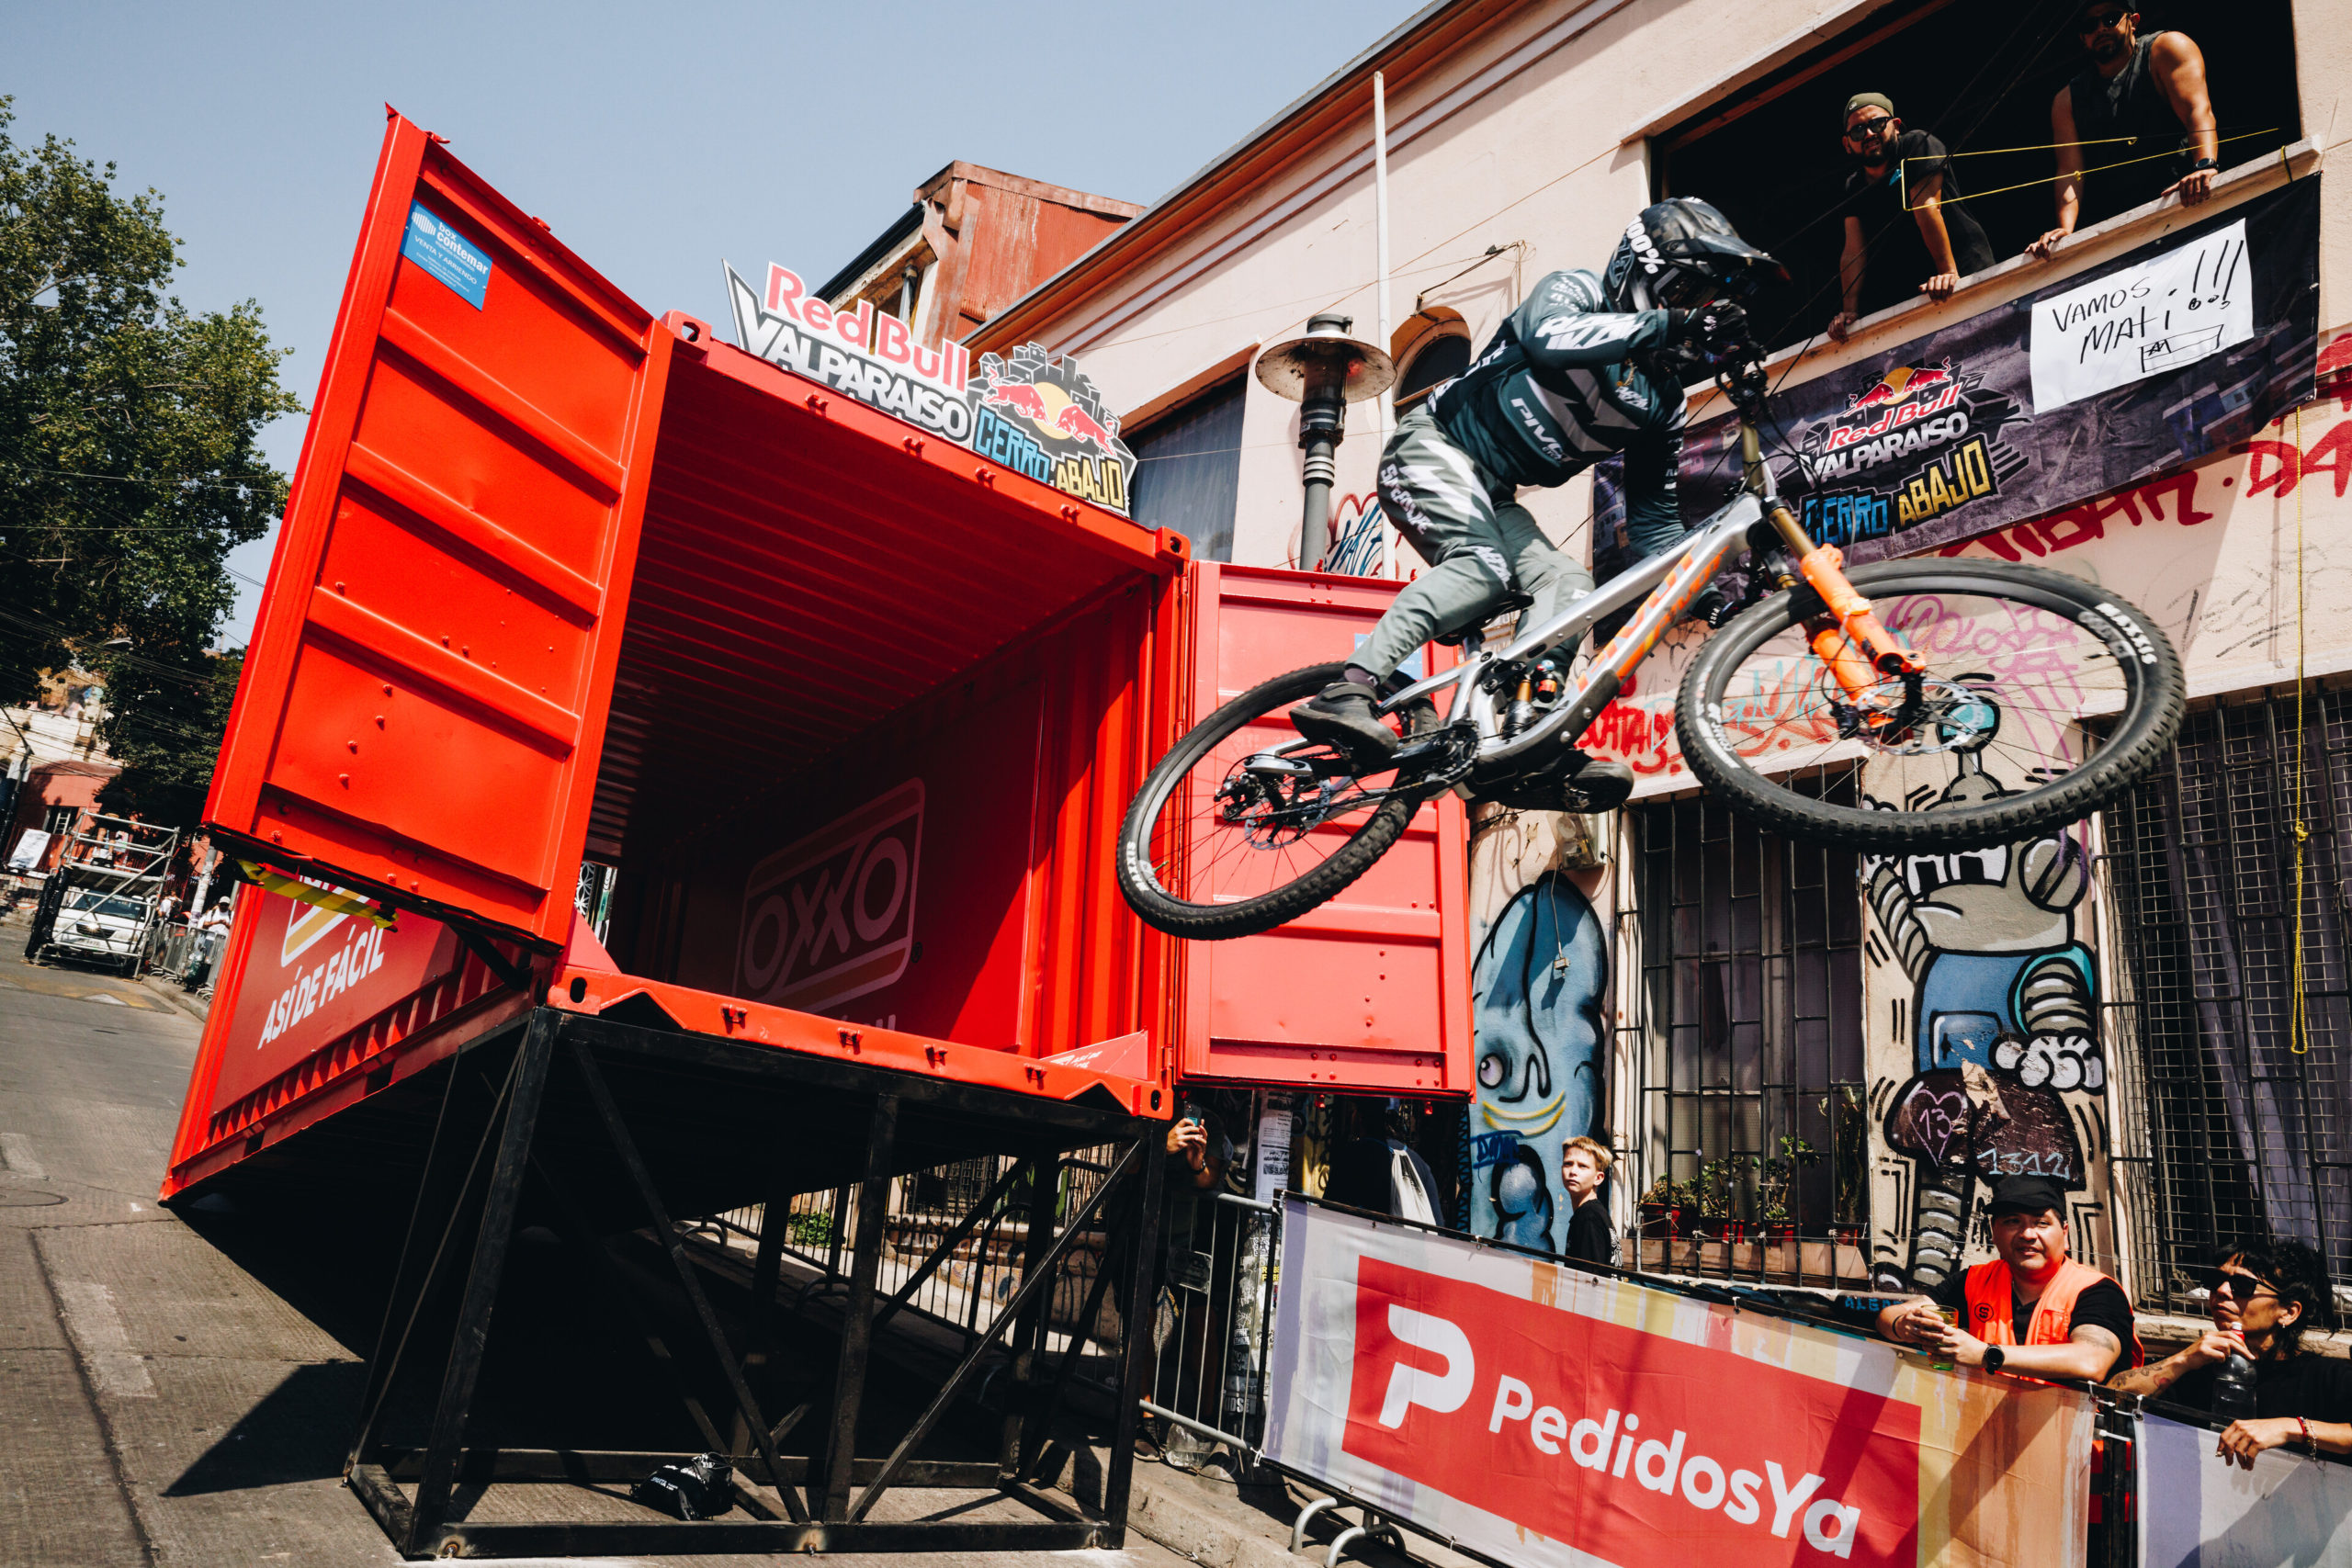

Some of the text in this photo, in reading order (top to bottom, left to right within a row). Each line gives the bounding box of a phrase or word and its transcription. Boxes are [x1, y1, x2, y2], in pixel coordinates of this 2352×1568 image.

[414, 235, 437, 254] VENTA
[443, 257, 477, 285] ARRIENDO
[436, 231, 488, 275] contemar
[438, 222, 457, 241] box
[1626, 215, 1666, 275] 100%
[767, 264, 968, 393] Red Bull
[2052, 276, 2151, 332] VAMOS
[732, 274, 970, 440] VALPARAISO
[976, 407, 1051, 484] CERRO
[1825, 382, 1963, 452] Red Bull
[1800, 412, 1968, 490] VALPARAISO
[1057, 459, 1124, 509] ABAJO
[1898, 439, 1991, 527] ABAJO
[1805, 494, 1888, 547] CERRO
[2095, 603, 2157, 664] MAXXIS
[1126, 841, 1150, 891] MAXXIS
[743, 837, 909, 991] OXXO
[257, 924, 384, 1050] ASÍ DE FÁCIL
[1919, 1108, 1952, 1139] 13
[1976, 1148, 2071, 1179] 1312
[1488, 1373, 1861, 1560] PedidosYa
